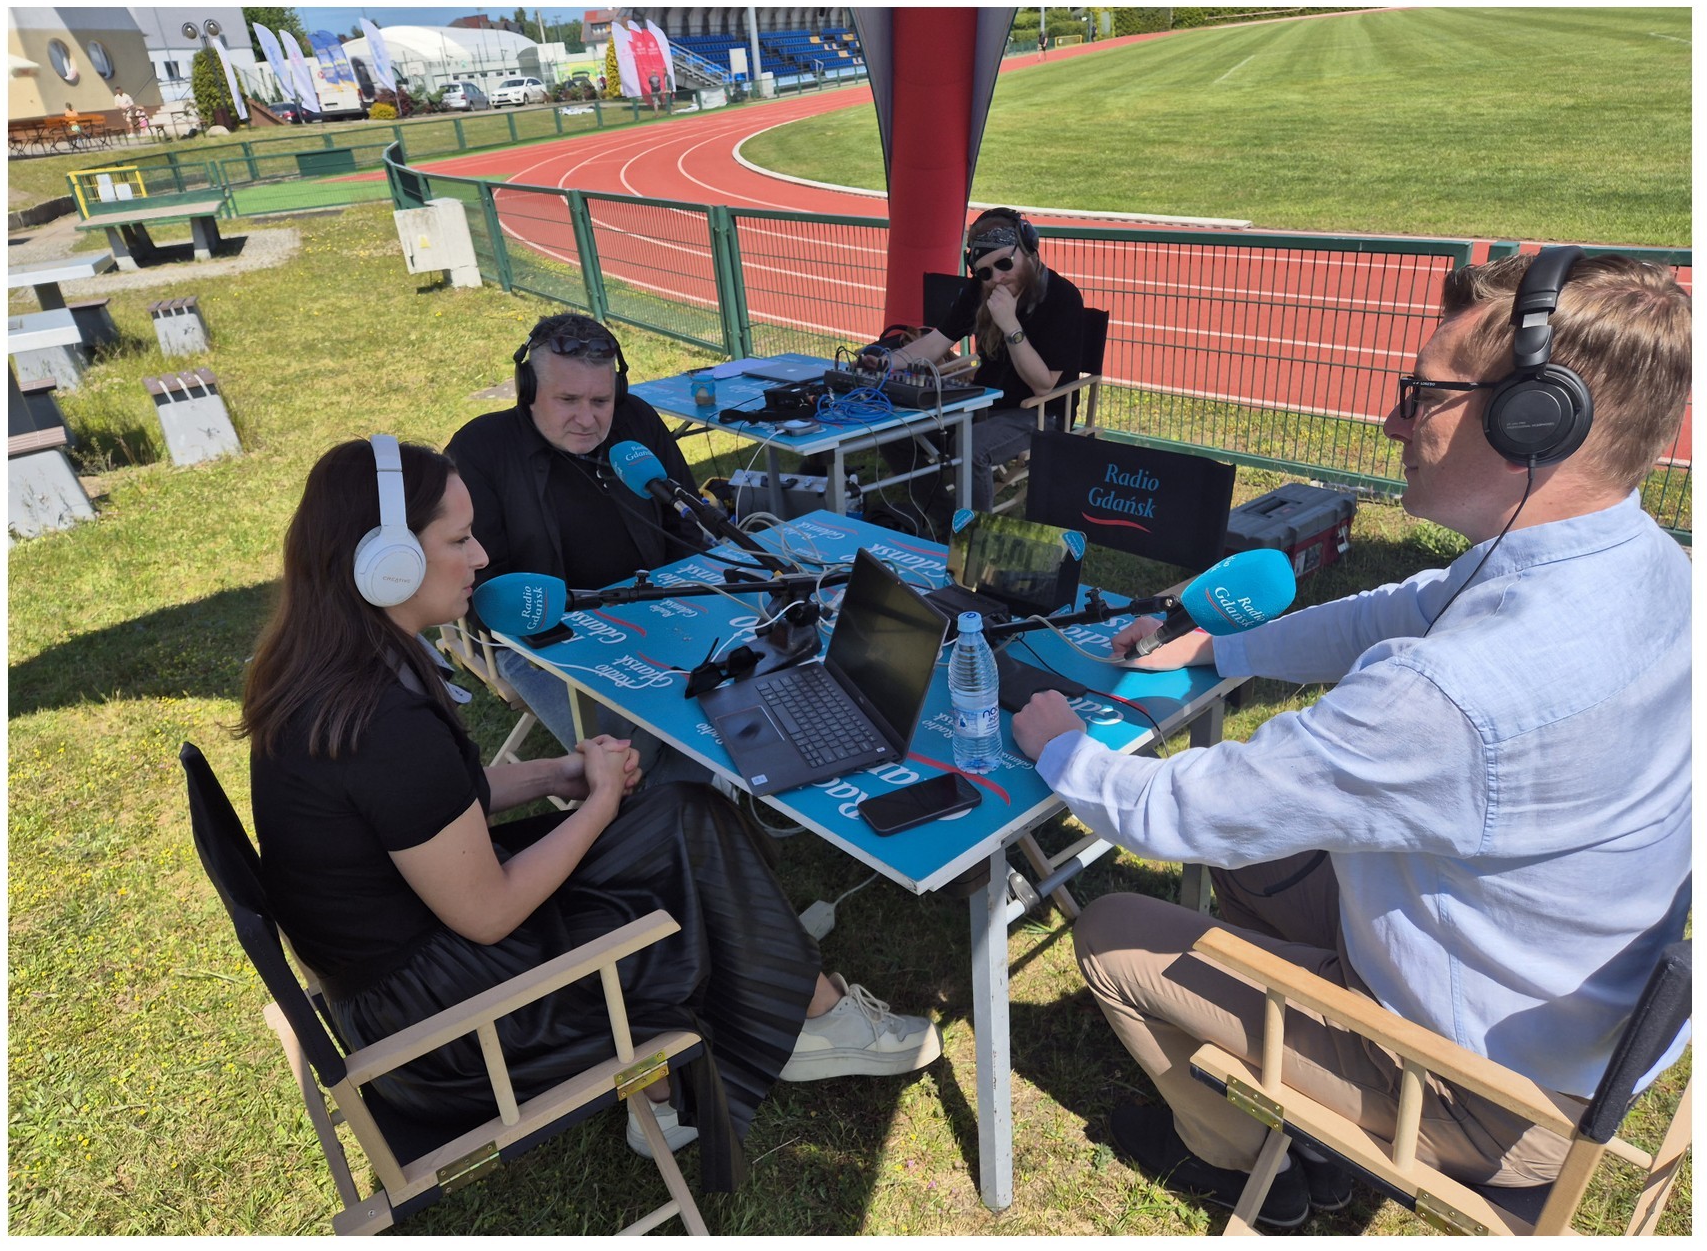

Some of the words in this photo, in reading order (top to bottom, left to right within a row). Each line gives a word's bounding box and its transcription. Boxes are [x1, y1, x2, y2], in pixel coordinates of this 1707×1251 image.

[1104, 464, 1160, 491] Radio
[1088, 487, 1157, 518] Gdańsk
[522, 586, 532, 618] Radio
[527, 587, 543, 630] Gdańsk
[1215, 587, 1255, 627] Gdańsk
[1238, 596, 1265, 622] Radio
